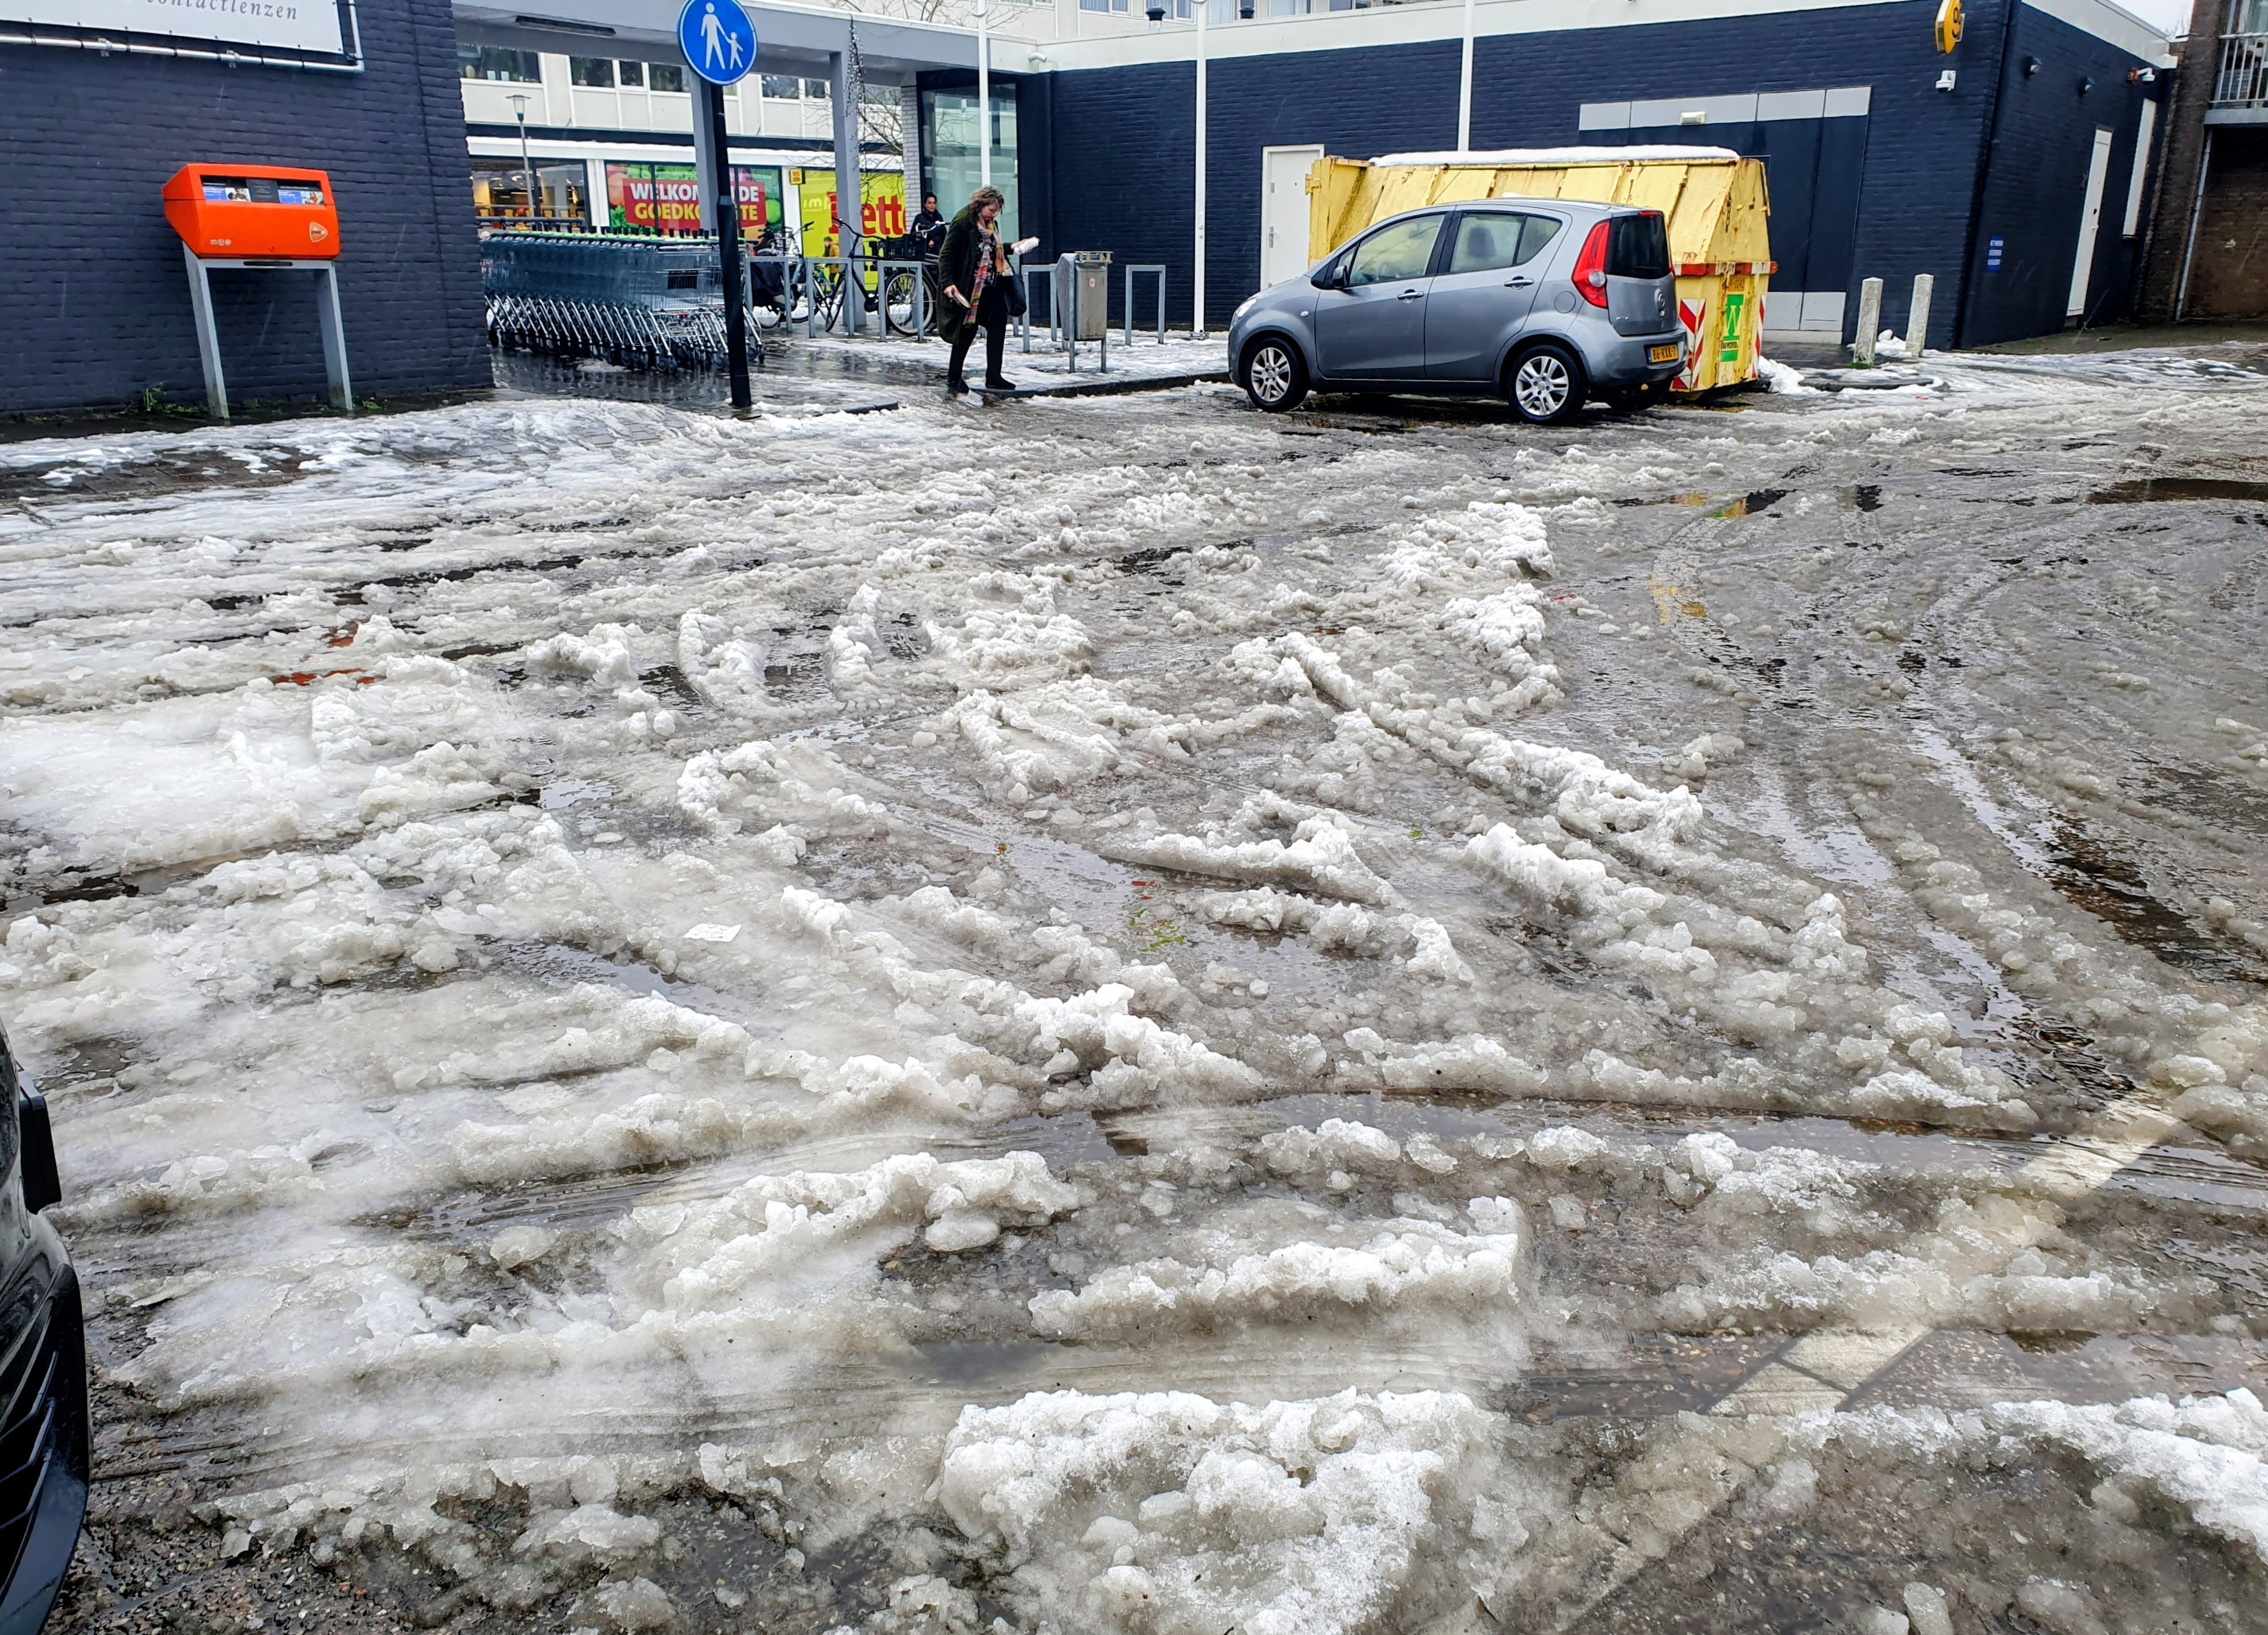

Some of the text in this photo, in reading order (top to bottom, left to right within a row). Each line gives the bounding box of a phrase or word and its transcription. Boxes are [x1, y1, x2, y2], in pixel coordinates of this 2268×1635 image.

[147, 0, 296, 20] nactlenzen
[738, 186, 759, 202] DE
[634, 202, 758, 220] GOEDKTE
[827, 192, 907, 235] ett
